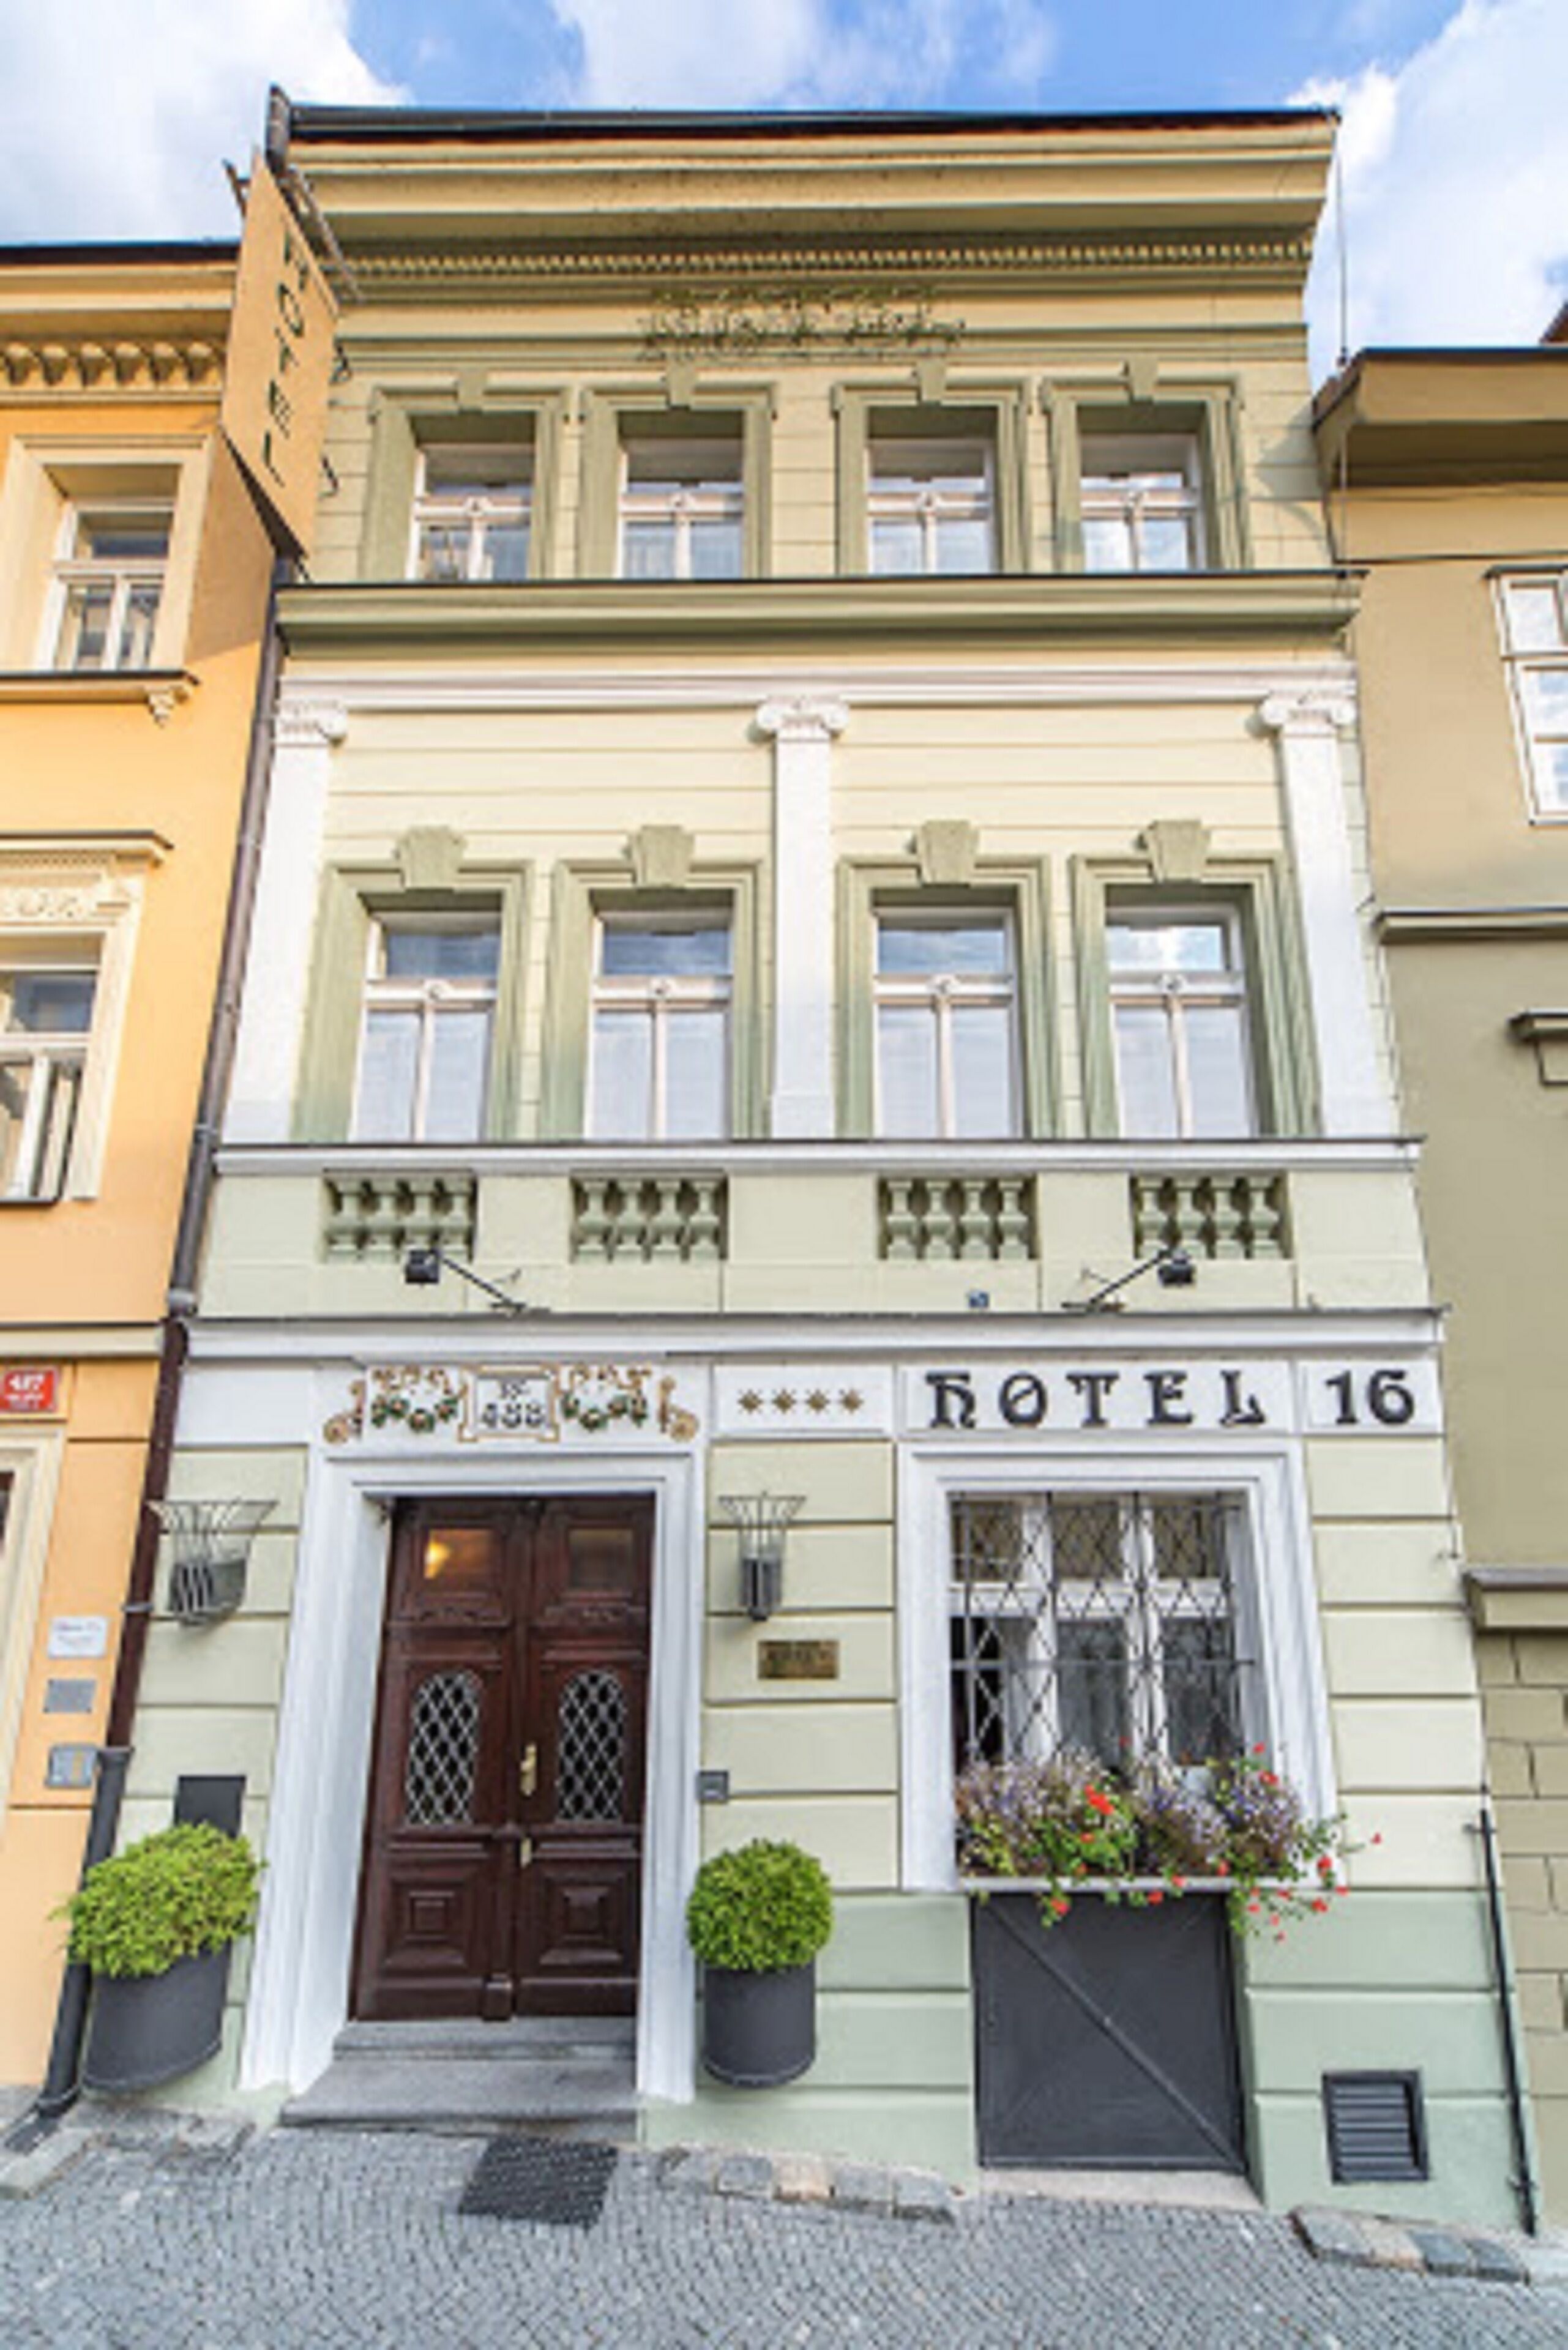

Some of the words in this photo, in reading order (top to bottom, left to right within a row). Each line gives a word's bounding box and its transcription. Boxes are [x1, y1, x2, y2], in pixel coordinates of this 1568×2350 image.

[263, 225, 308, 487] HOTEL
[925, 1370, 1265, 1428] HOTEL
[1326, 1370, 1416, 1425] 16
